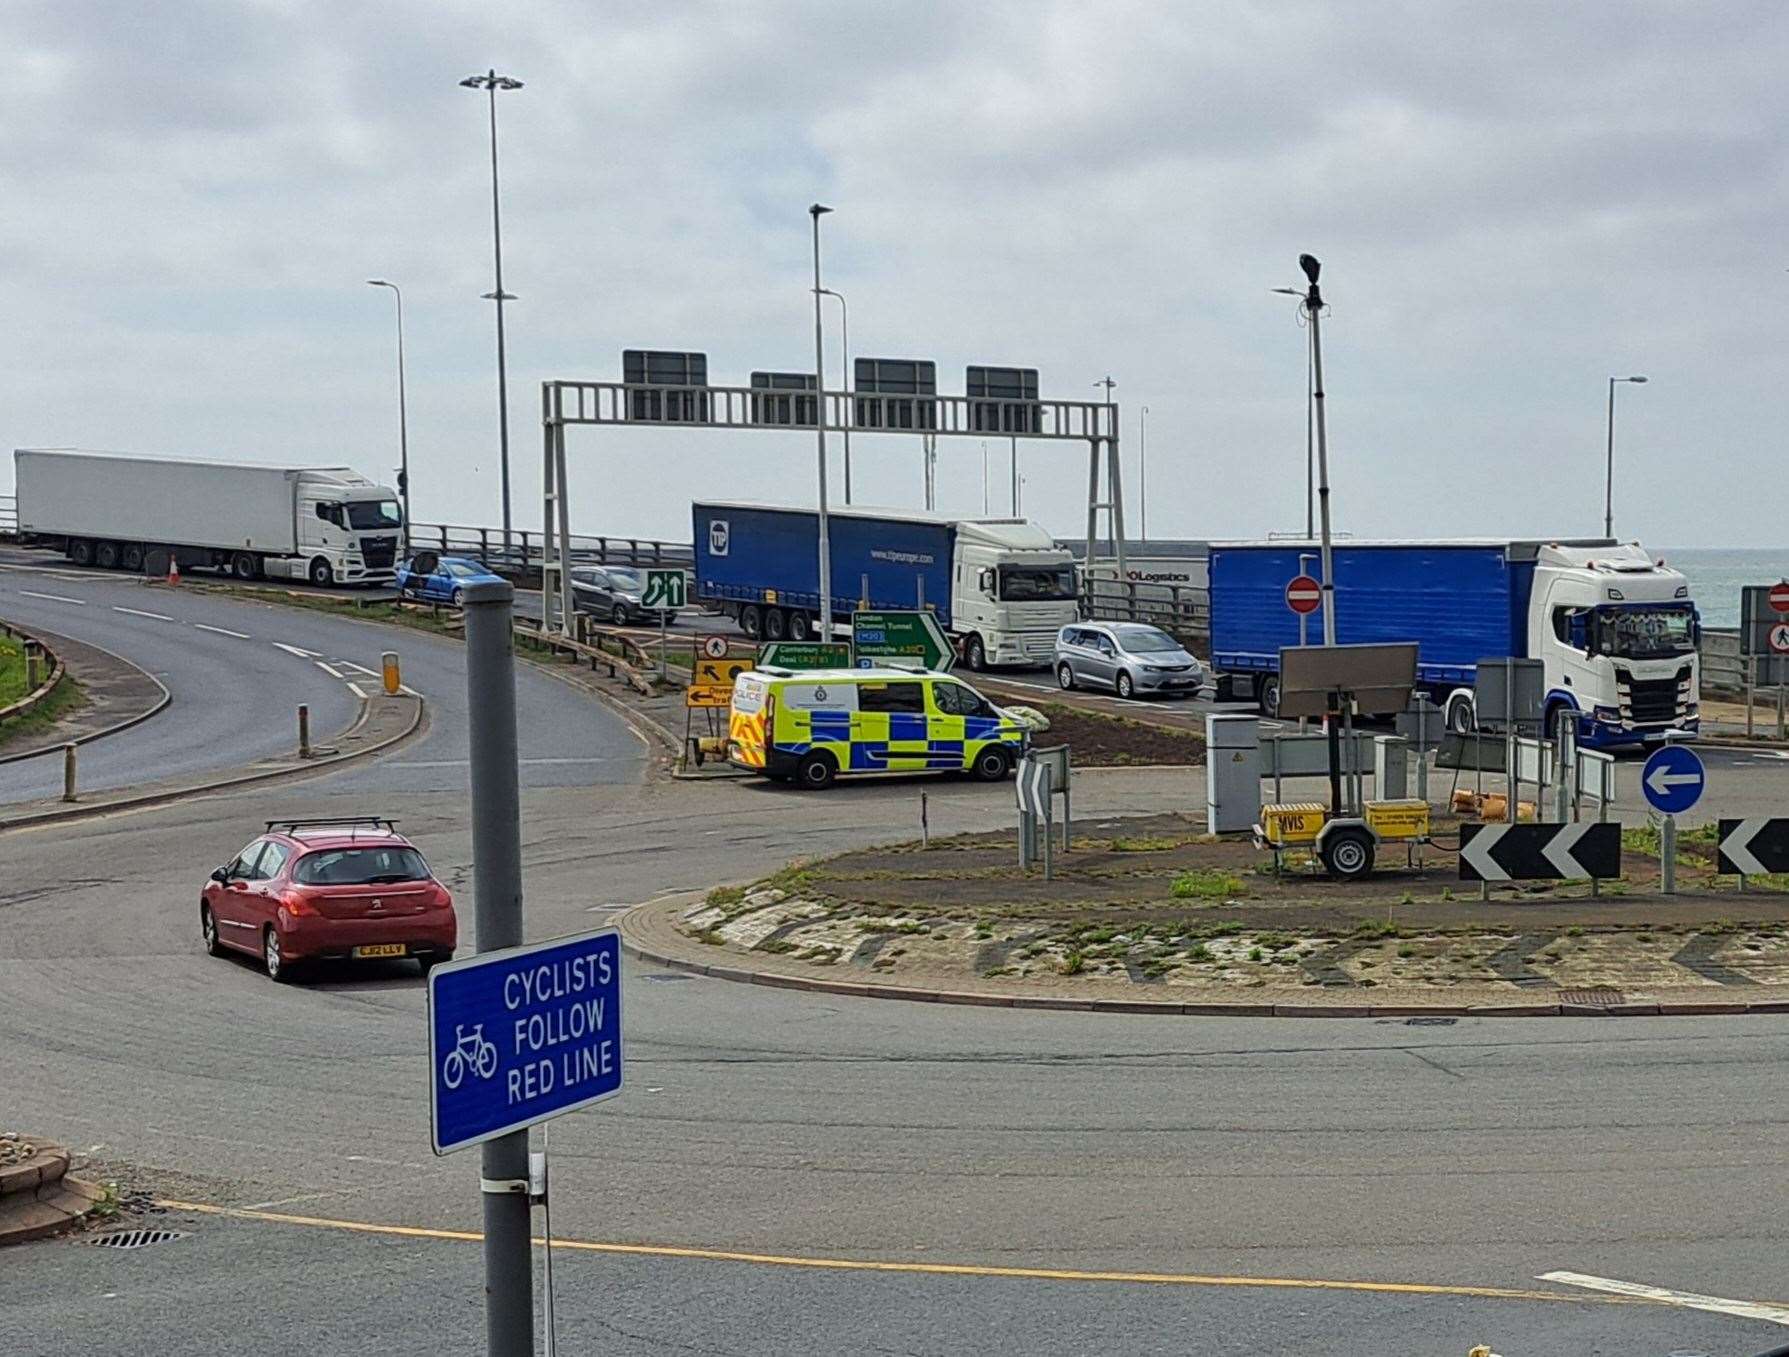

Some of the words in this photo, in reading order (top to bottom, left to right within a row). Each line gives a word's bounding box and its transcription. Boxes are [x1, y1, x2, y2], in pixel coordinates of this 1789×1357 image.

[504, 951, 611, 1009] CYCLISTS
[515, 997, 604, 1055] FOLLOW
[508, 1059, 554, 1104] RED
[564, 1040, 612, 1086] LINE
